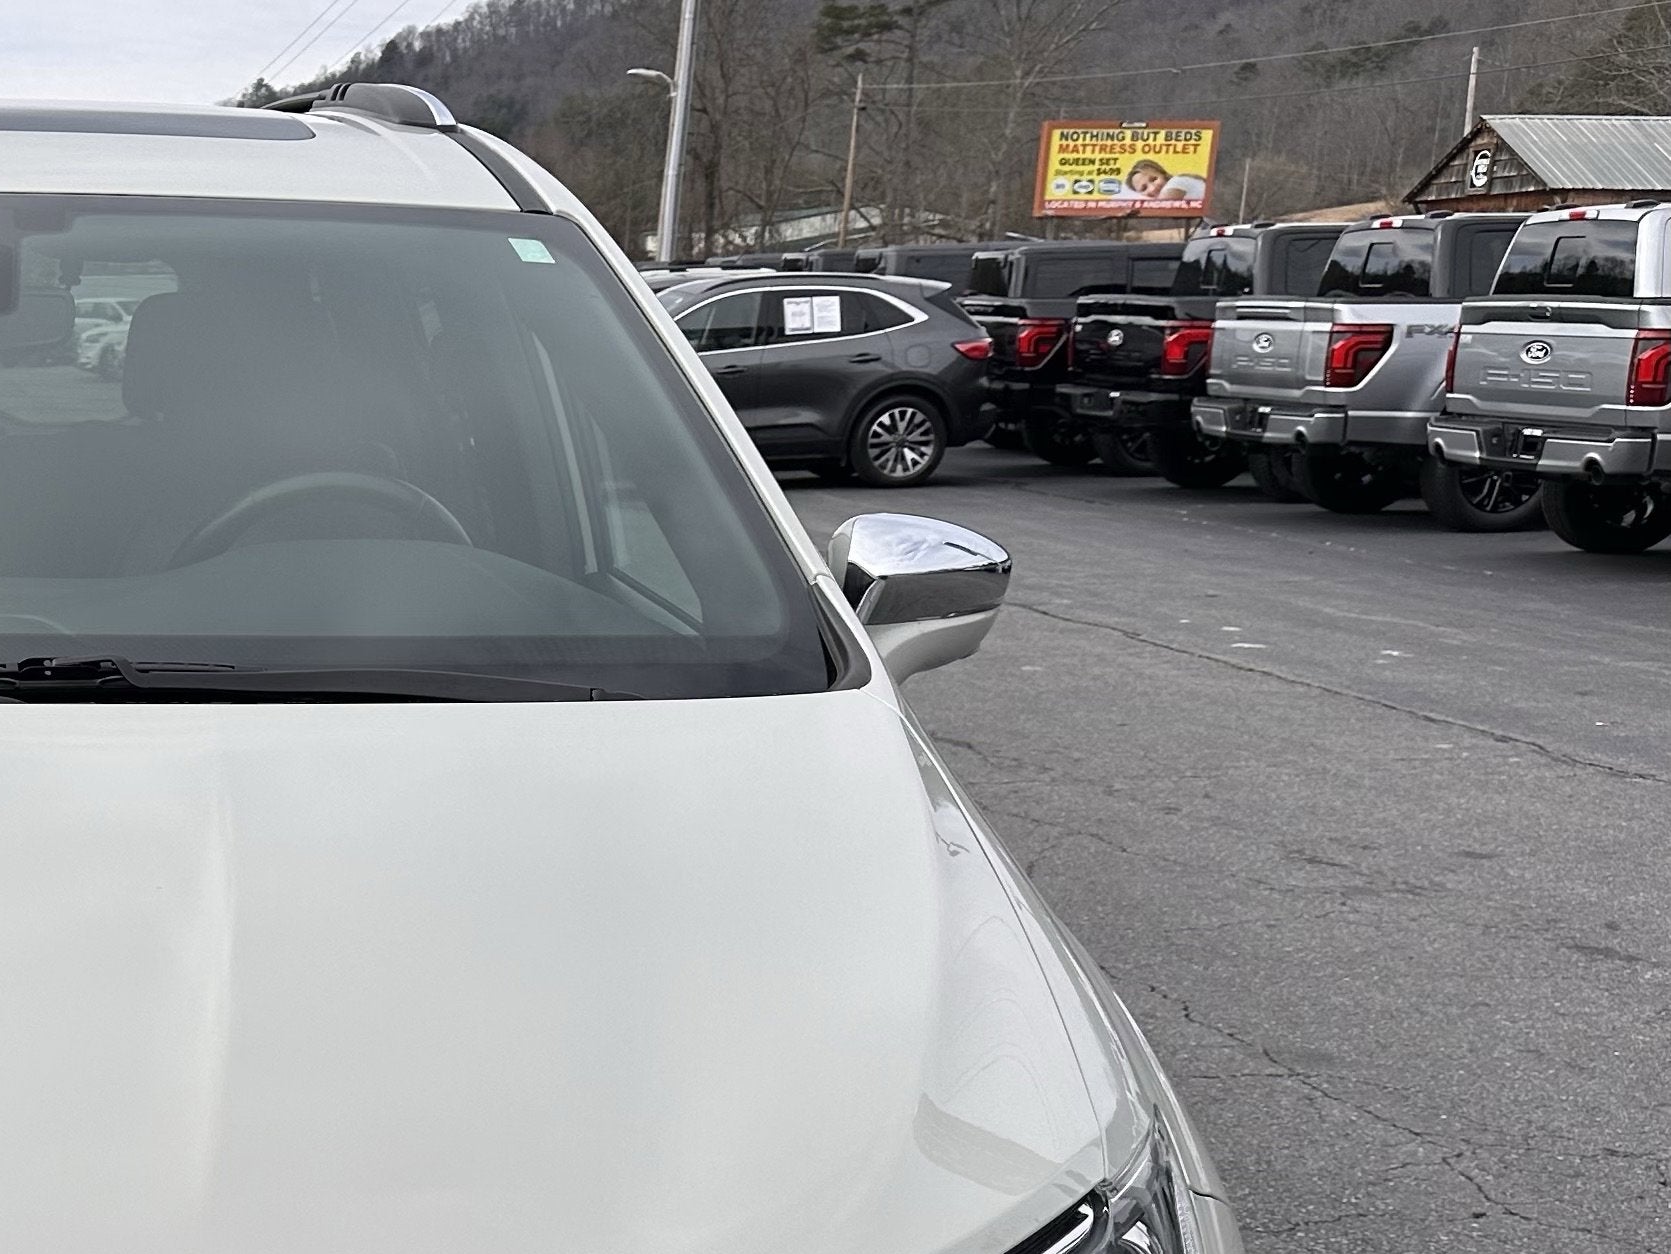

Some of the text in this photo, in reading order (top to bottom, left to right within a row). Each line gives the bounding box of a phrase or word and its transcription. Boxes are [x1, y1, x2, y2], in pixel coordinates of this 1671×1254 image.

[1059, 131, 1202, 142] NOTHING BUT BEDS
[1057, 143, 1201, 154] MATTRESS OUTLET
[1059, 157, 1119, 166] QUEEN SET
[1479, 367, 1593, 391] F-150
